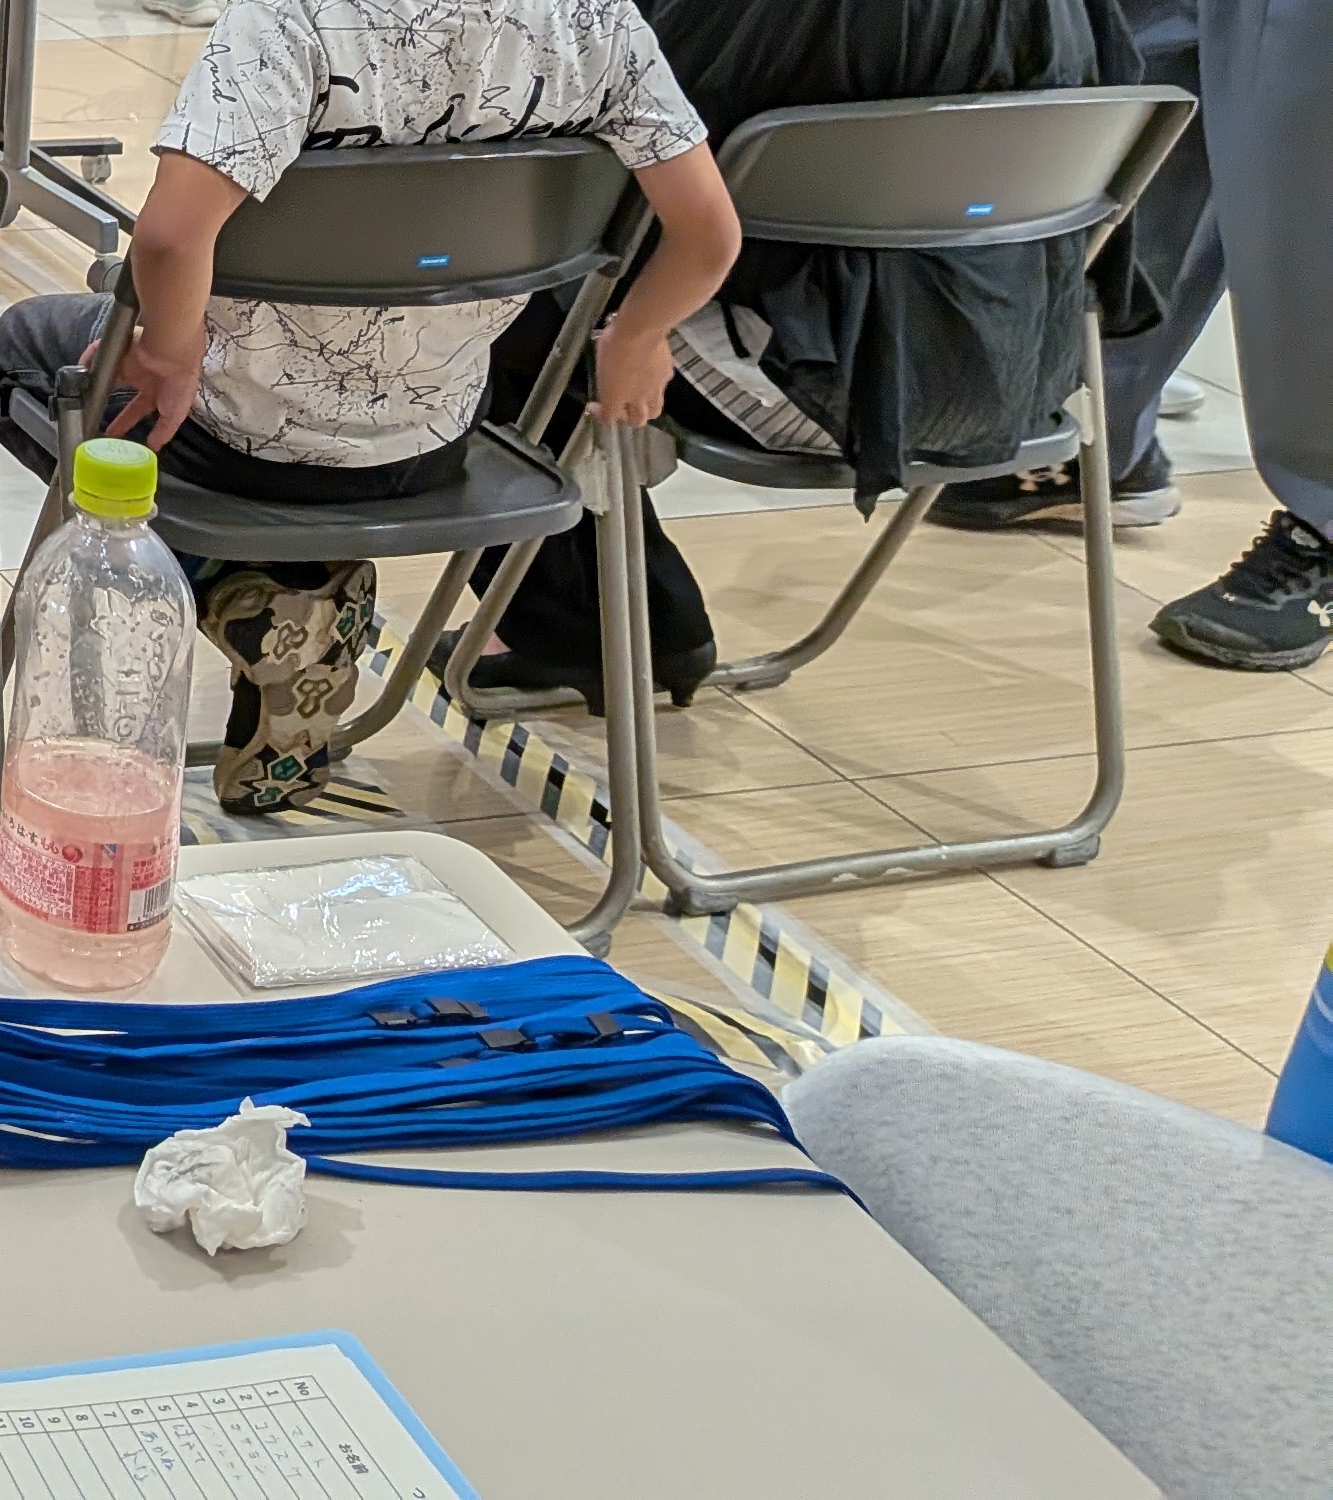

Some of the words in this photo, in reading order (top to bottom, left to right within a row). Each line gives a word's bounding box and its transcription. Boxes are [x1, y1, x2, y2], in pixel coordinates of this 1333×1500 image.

[294, 1381, 310, 1396] No
[18, 1416, 35, 1429] 10
[338, 1443, 369, 1475] お名前
